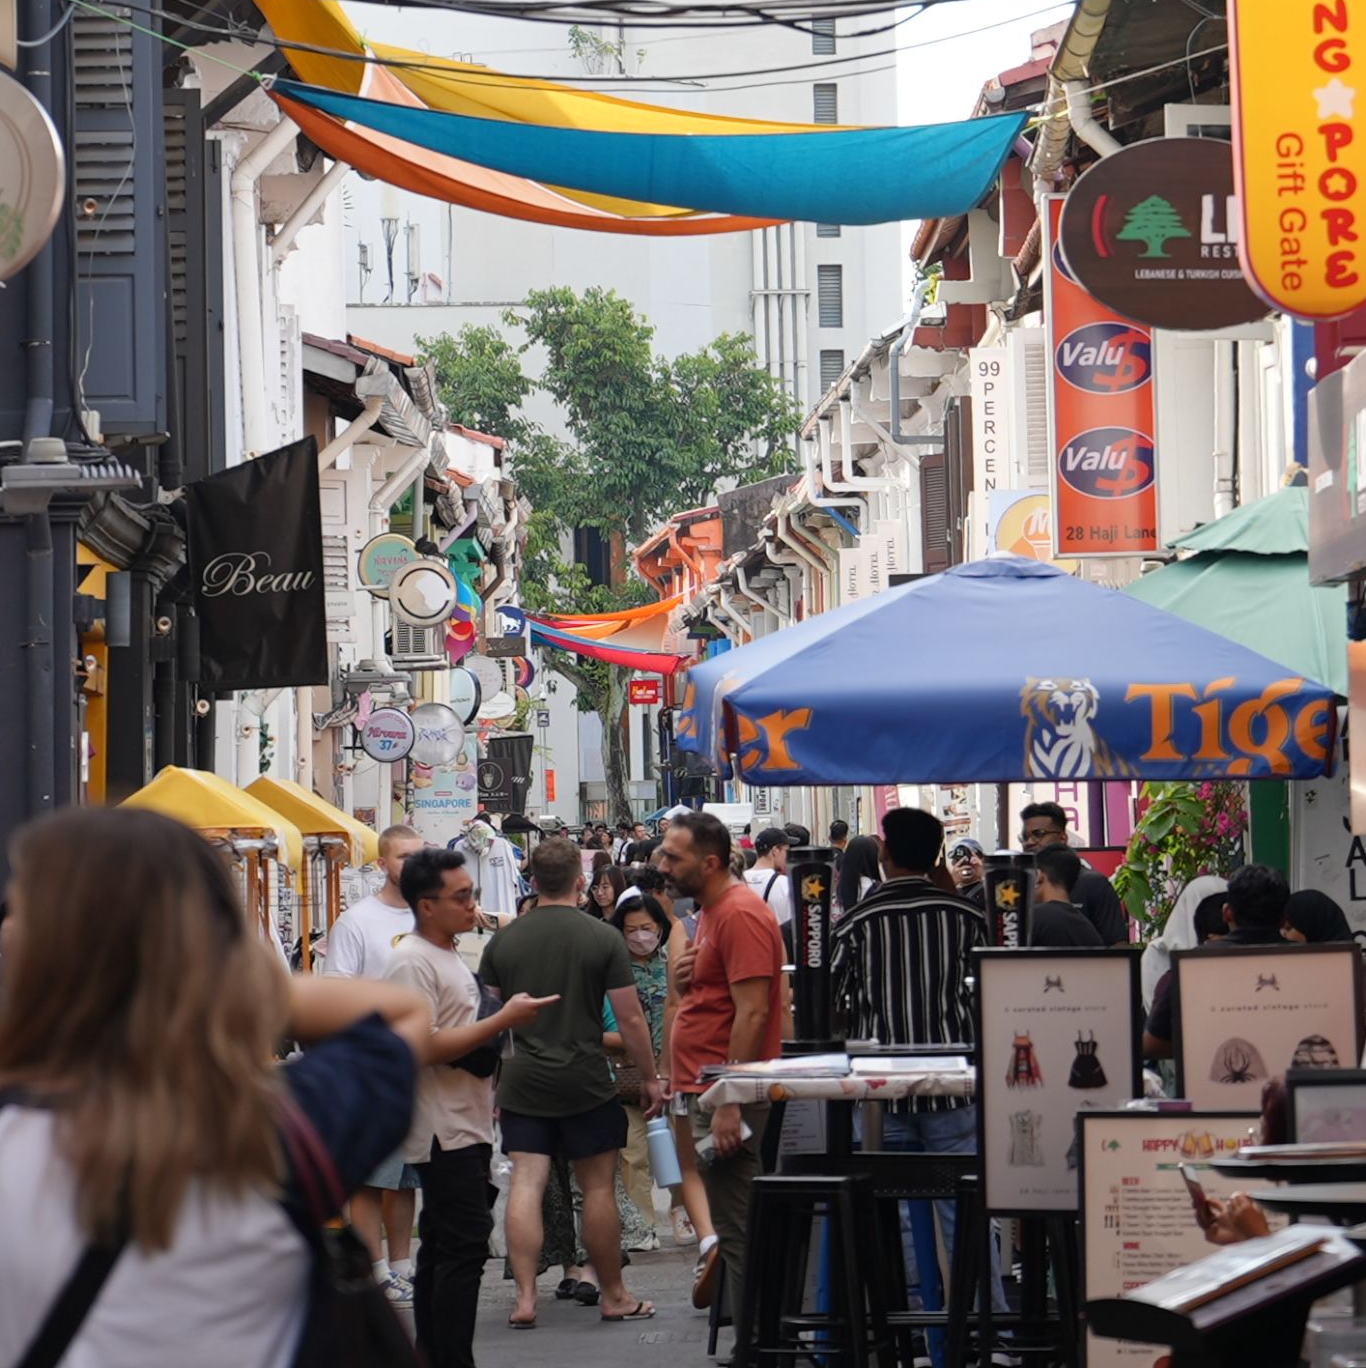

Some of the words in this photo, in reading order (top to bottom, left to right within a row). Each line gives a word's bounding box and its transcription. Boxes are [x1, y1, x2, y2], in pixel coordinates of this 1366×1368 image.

[1275, 132, 1306, 197] Gift
[1278, 205, 1307, 292] Gate
[1134, 268, 1177, 280] LEBANESE
[1178, 268, 1184, 280] &
[1185, 268, 1220, 280] TURKISH
[978, 361, 1001, 377] 99
[1066, 526, 1084, 540] 28
[1089, 525, 1119, 544] Haji
[1123, 525, 1157, 539] Lane
[201, 552, 316, 598] Beau
[379, 739, 393, 751] 37
[414, 798, 472, 809] SINGAPORE
[806, 903, 822, 969] SAPPORO
[1142, 1139, 1177, 1152] HAPPY
